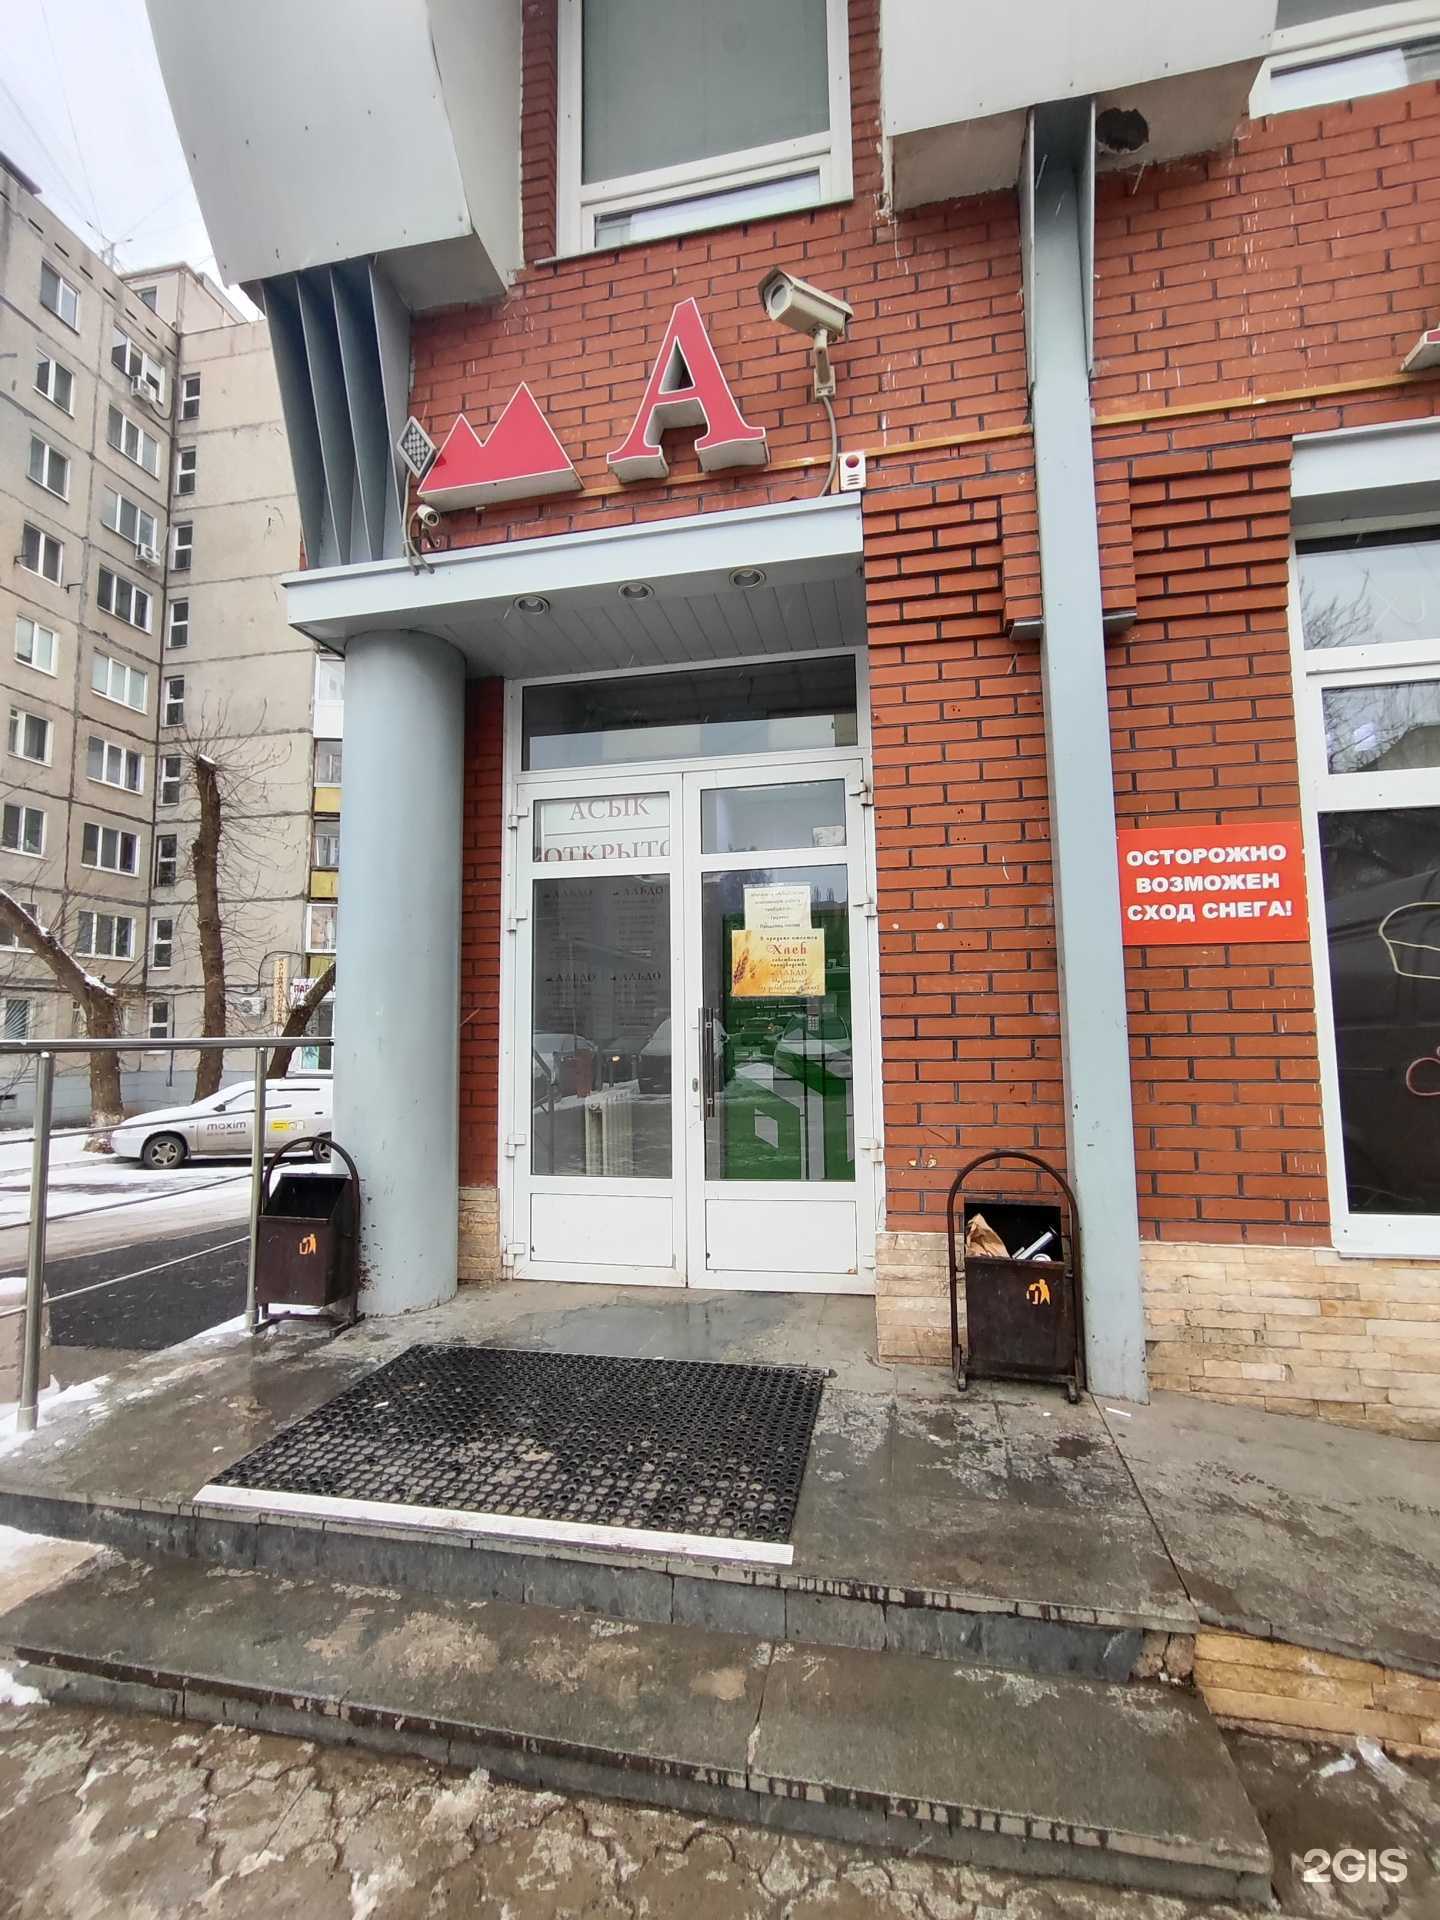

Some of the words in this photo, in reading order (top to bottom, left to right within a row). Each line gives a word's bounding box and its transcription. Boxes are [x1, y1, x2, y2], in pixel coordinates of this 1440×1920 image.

[1126, 844, 1287, 866] ОСТОРОЖНО
[1135, 872, 1280, 893] ВОЗМОЖЕН
[1127, 903, 1196, 923] СХОД
[1202, 900, 1293, 919] СНЕГА!
[206, 1120, 247, 1131] maxim
